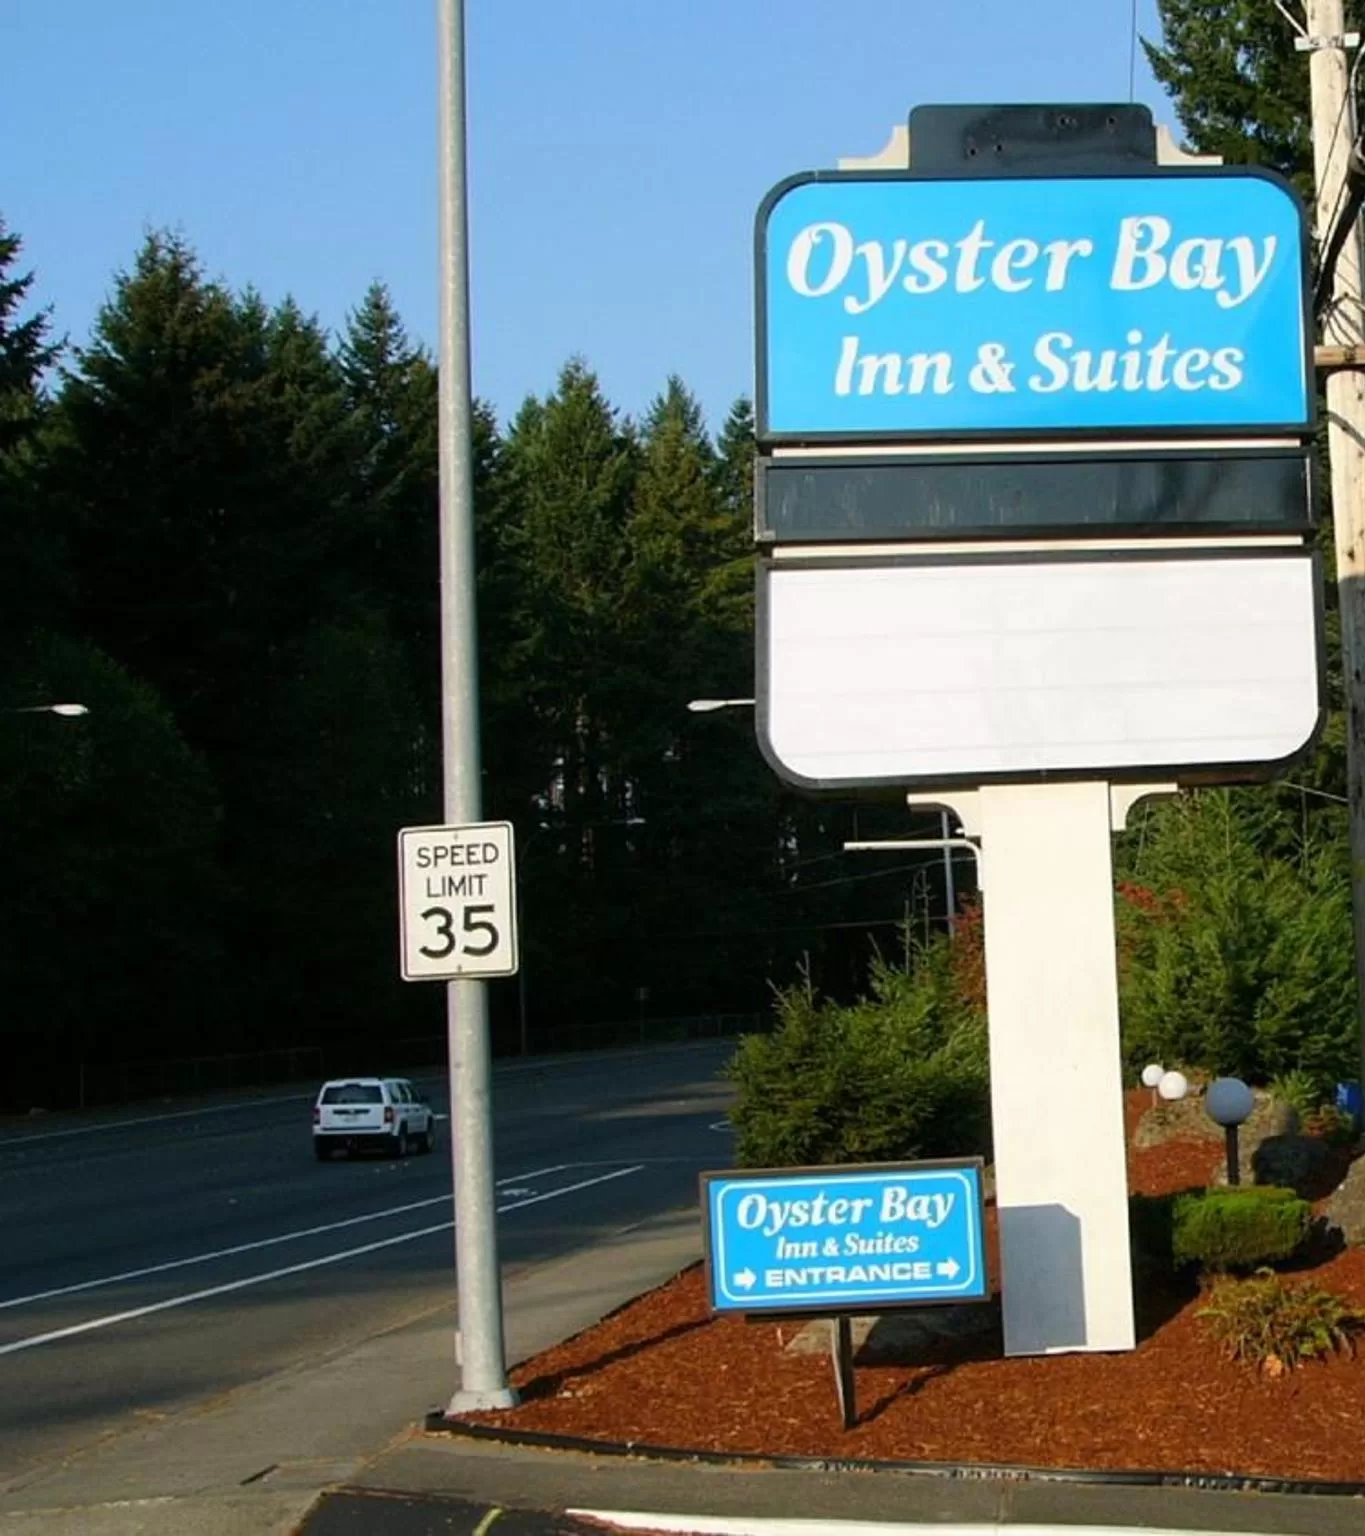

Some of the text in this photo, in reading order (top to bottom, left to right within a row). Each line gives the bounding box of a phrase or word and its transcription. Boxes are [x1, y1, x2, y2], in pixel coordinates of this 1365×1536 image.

[787, 216, 1277, 314] Oyster Bay
[835, 329, 1245, 396] Inn & Suites
[416, 842, 499, 868] SPEED
[426, 873, 488, 898] LIMIT
[419, 904, 499, 959] 35
[737, 1186, 955, 1237] Oyster Bay
[776, 1231, 920, 1260] Inn & Suites
[765, 1261, 932, 1288] ENTRANCE
